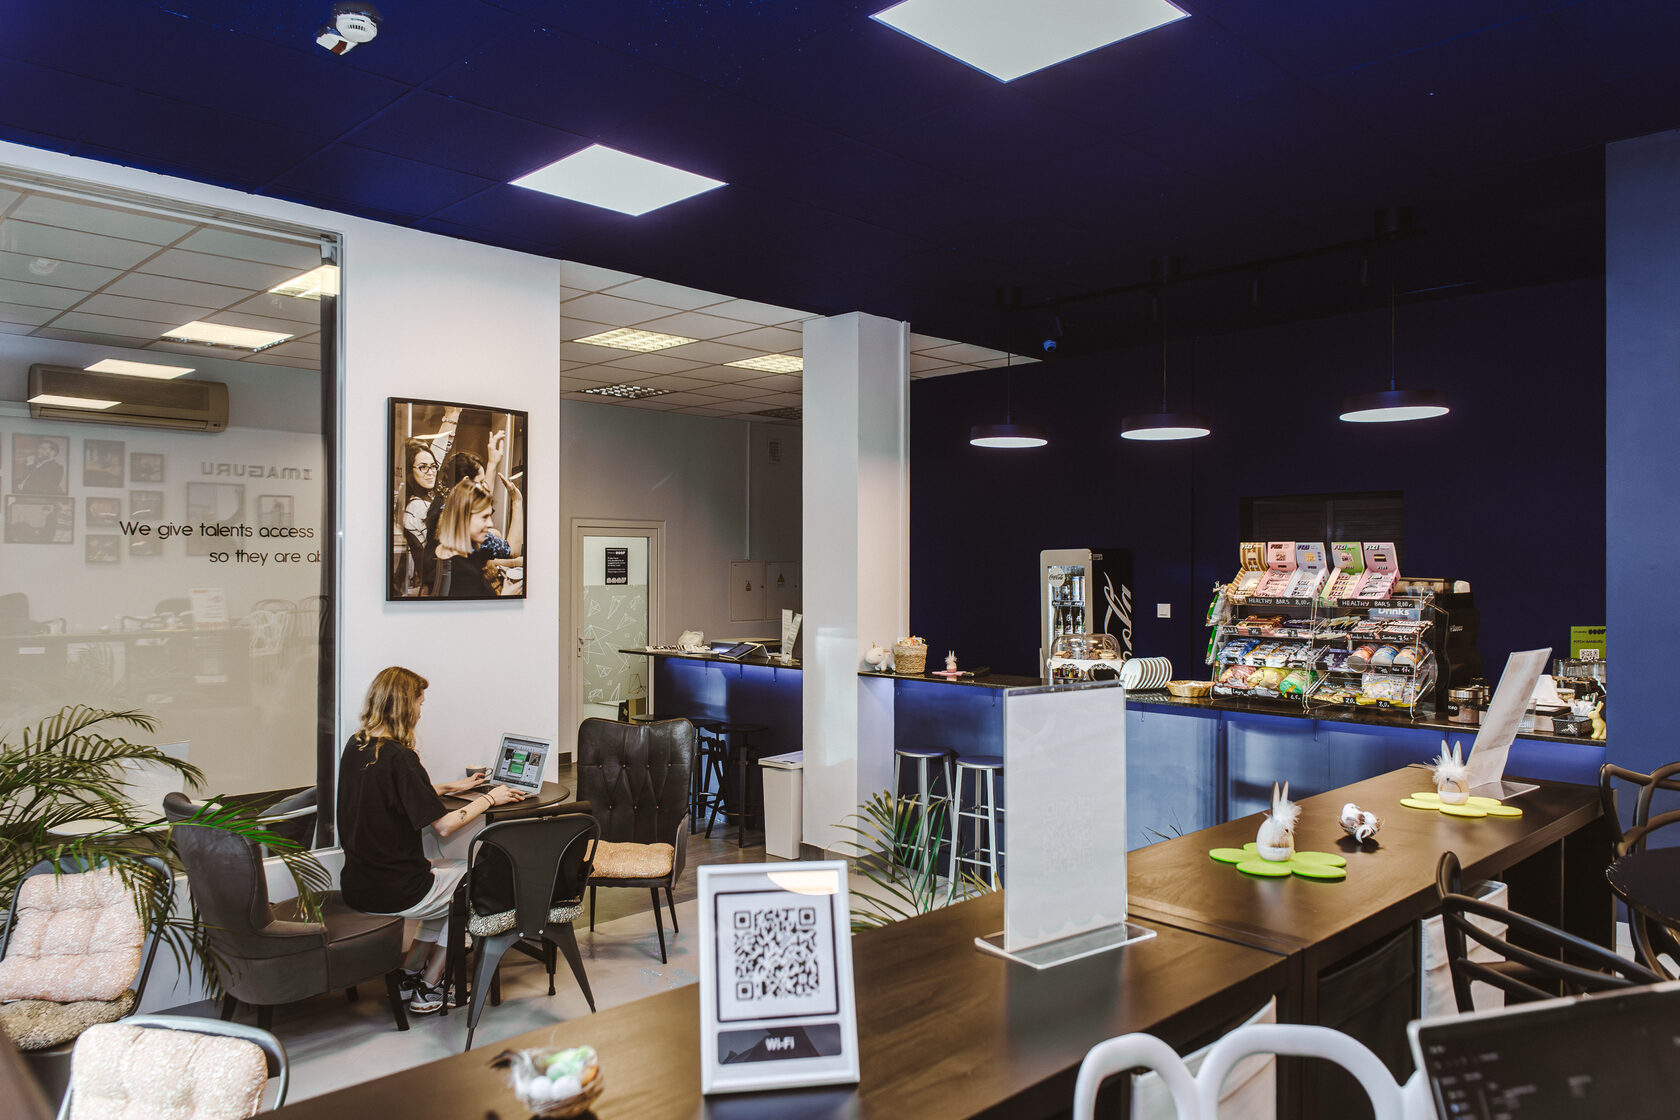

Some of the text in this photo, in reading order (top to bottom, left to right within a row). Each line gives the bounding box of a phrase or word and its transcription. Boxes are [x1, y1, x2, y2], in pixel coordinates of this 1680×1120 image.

[119, 521, 314, 540] We give talents access
[209, 552, 229, 563] so
[235, 549, 268, 566] they
[274, 552, 301, 563] are
